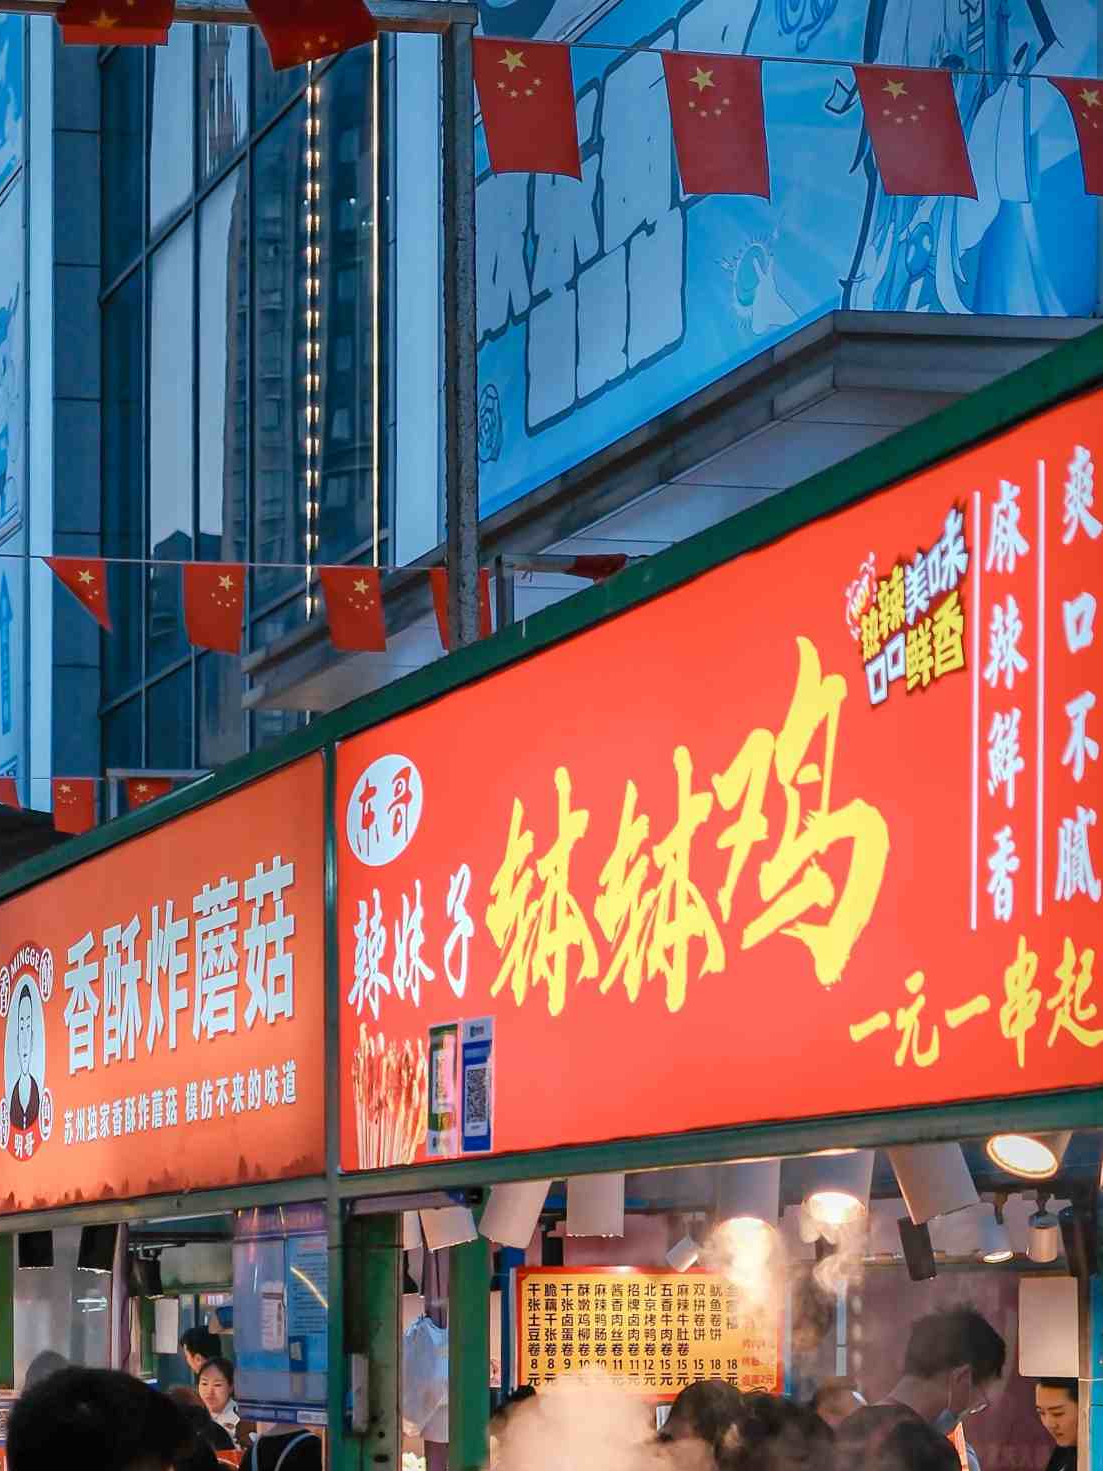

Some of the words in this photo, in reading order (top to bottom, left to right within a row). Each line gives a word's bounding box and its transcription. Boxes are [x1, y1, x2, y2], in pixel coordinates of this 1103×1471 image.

[10, 947, 40, 979] MINGGE
[64, 855, 294, 1075] 香酥炸蘑菇
[348, 864, 474, 1020] 辣妹子
[849, 935, 1103, 1068] 一元一串起
[14, 1131, 34, 1160] 明哥
[64, 1087, 178, 1145] 苏州独家香酥炸蘑菇
[644, 1283, 657, 1356] 北京烤鸭卷
[661, 1283, 673, 1356] 五香牛肉卷
[677, 1283, 689, 1356] 麻辣牛肚卷
[693, 1283, 706, 1341] 双拼卷饼
